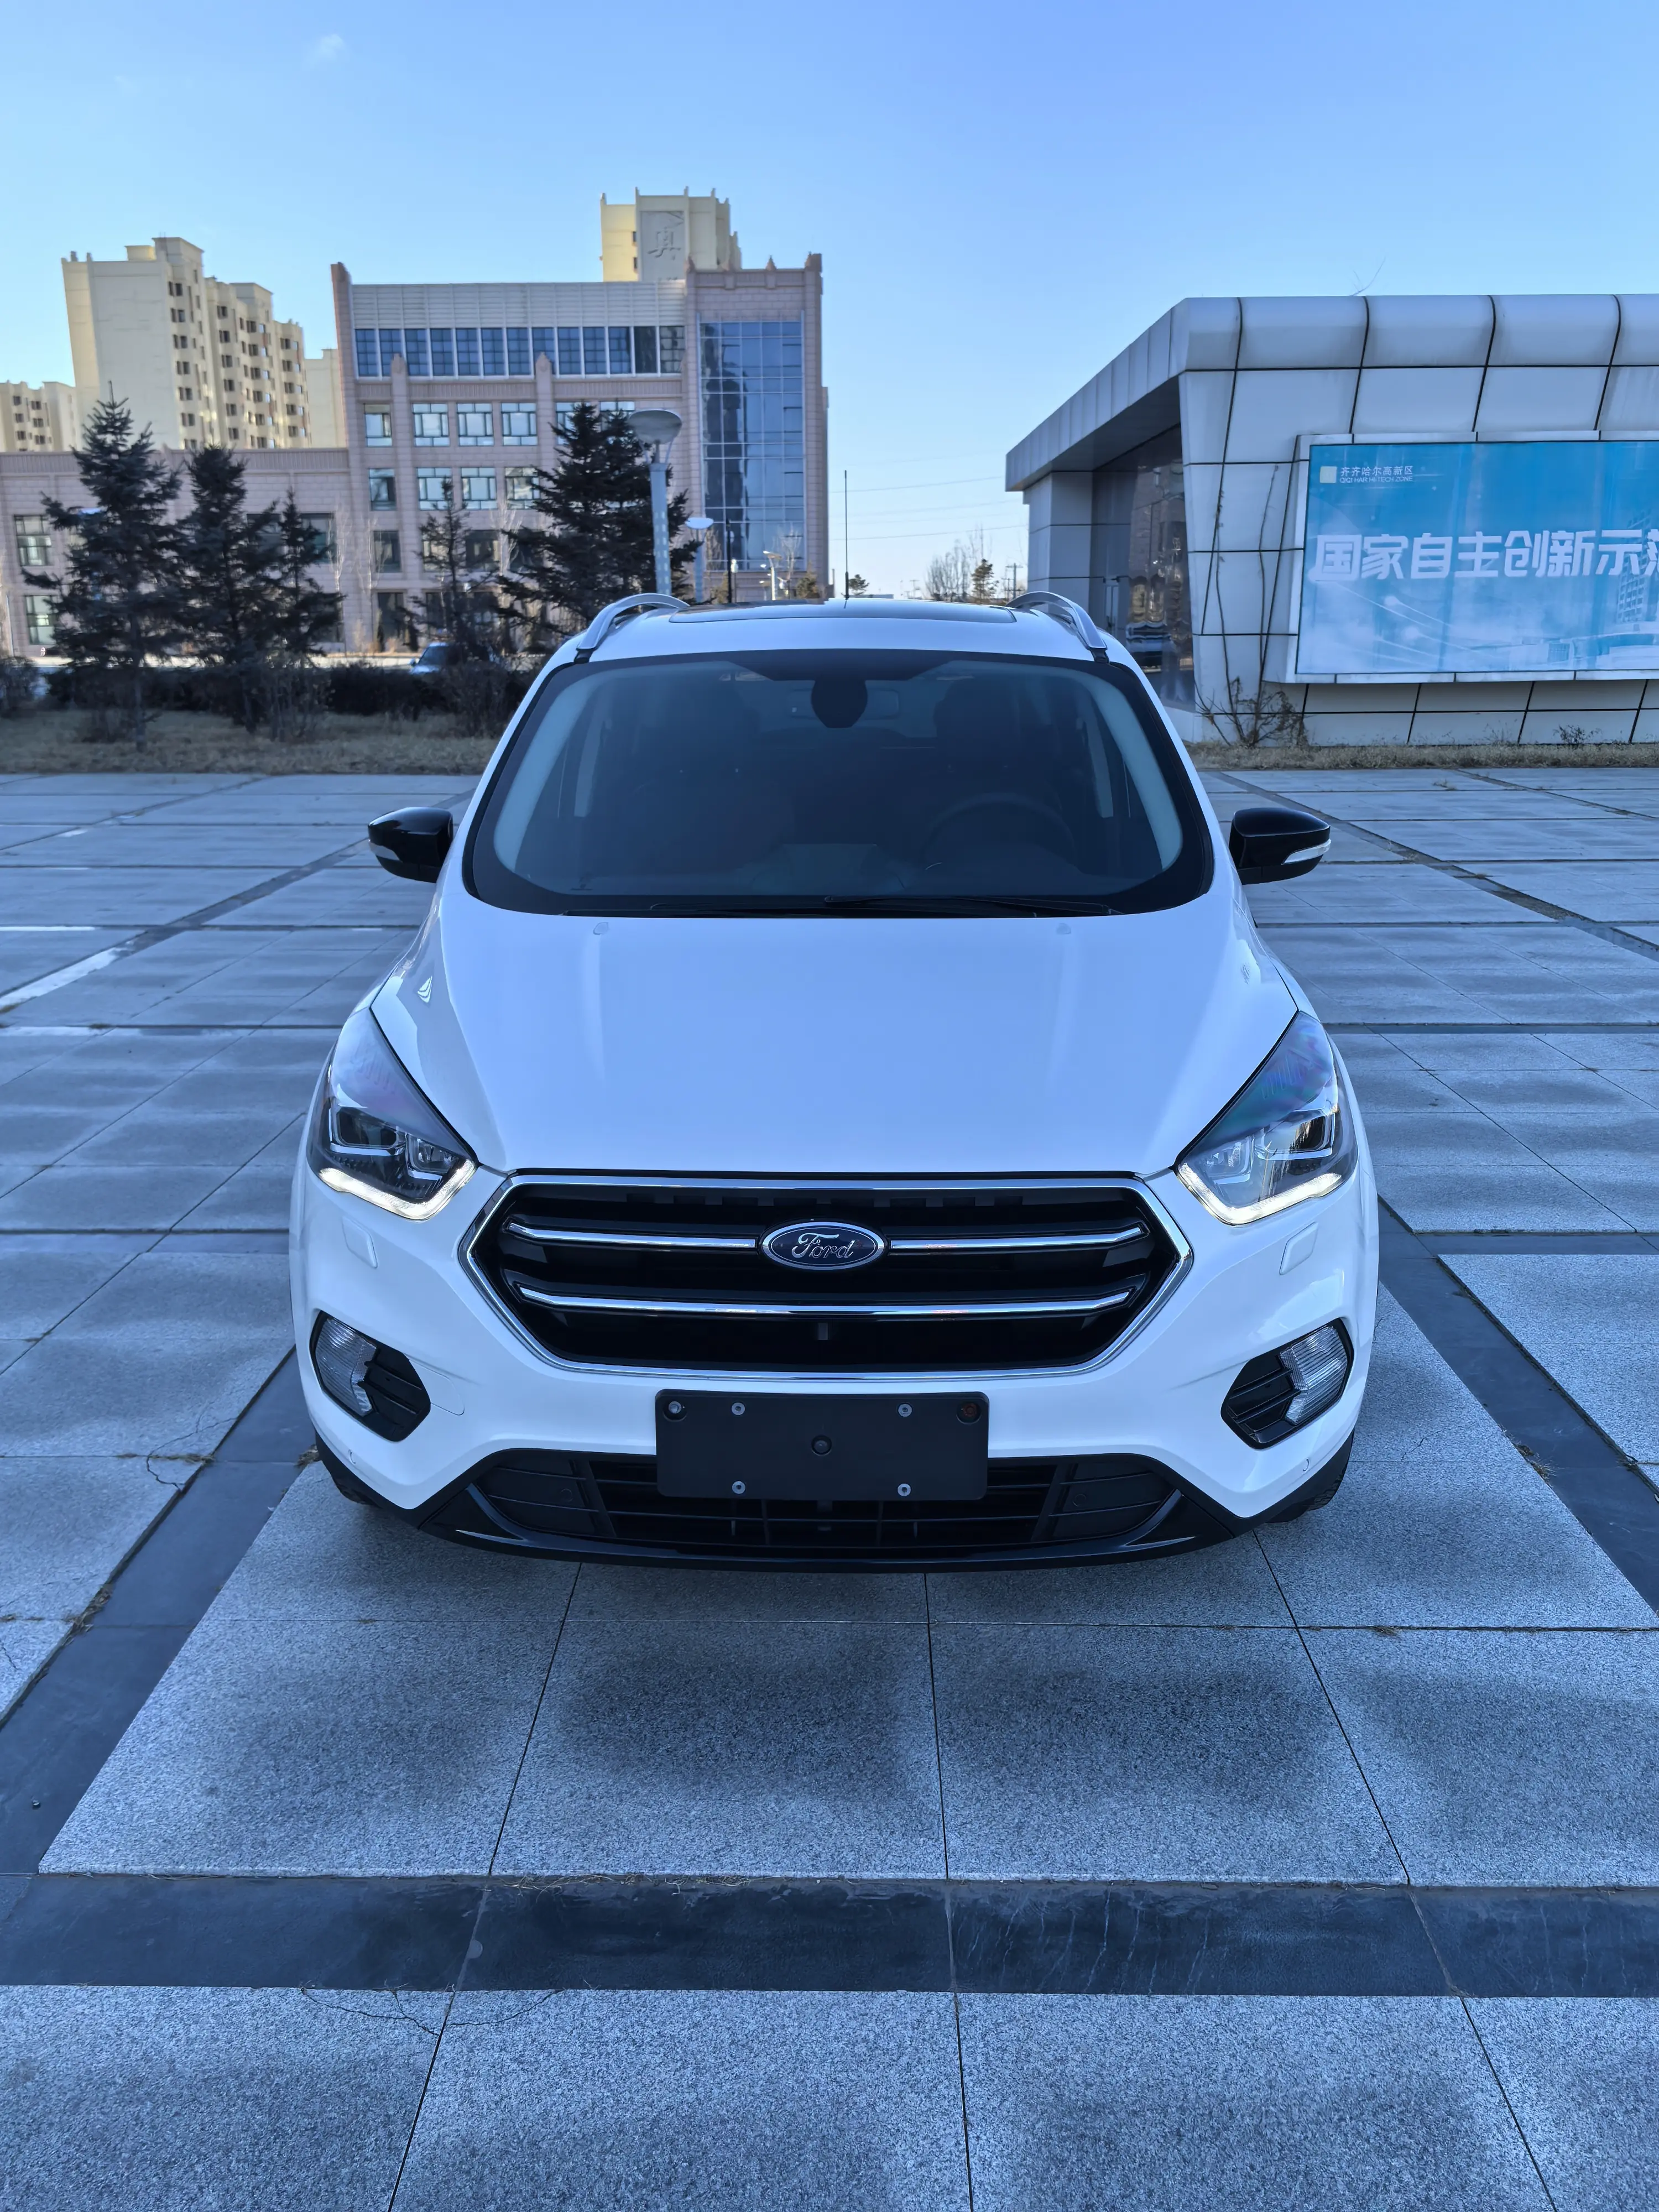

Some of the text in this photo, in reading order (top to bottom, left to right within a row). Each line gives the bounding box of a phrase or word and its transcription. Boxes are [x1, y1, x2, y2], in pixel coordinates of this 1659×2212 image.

[1340, 466, 1413, 477] 齐齐哈尔高新区
[791, 1233, 855, 1258] Ford
